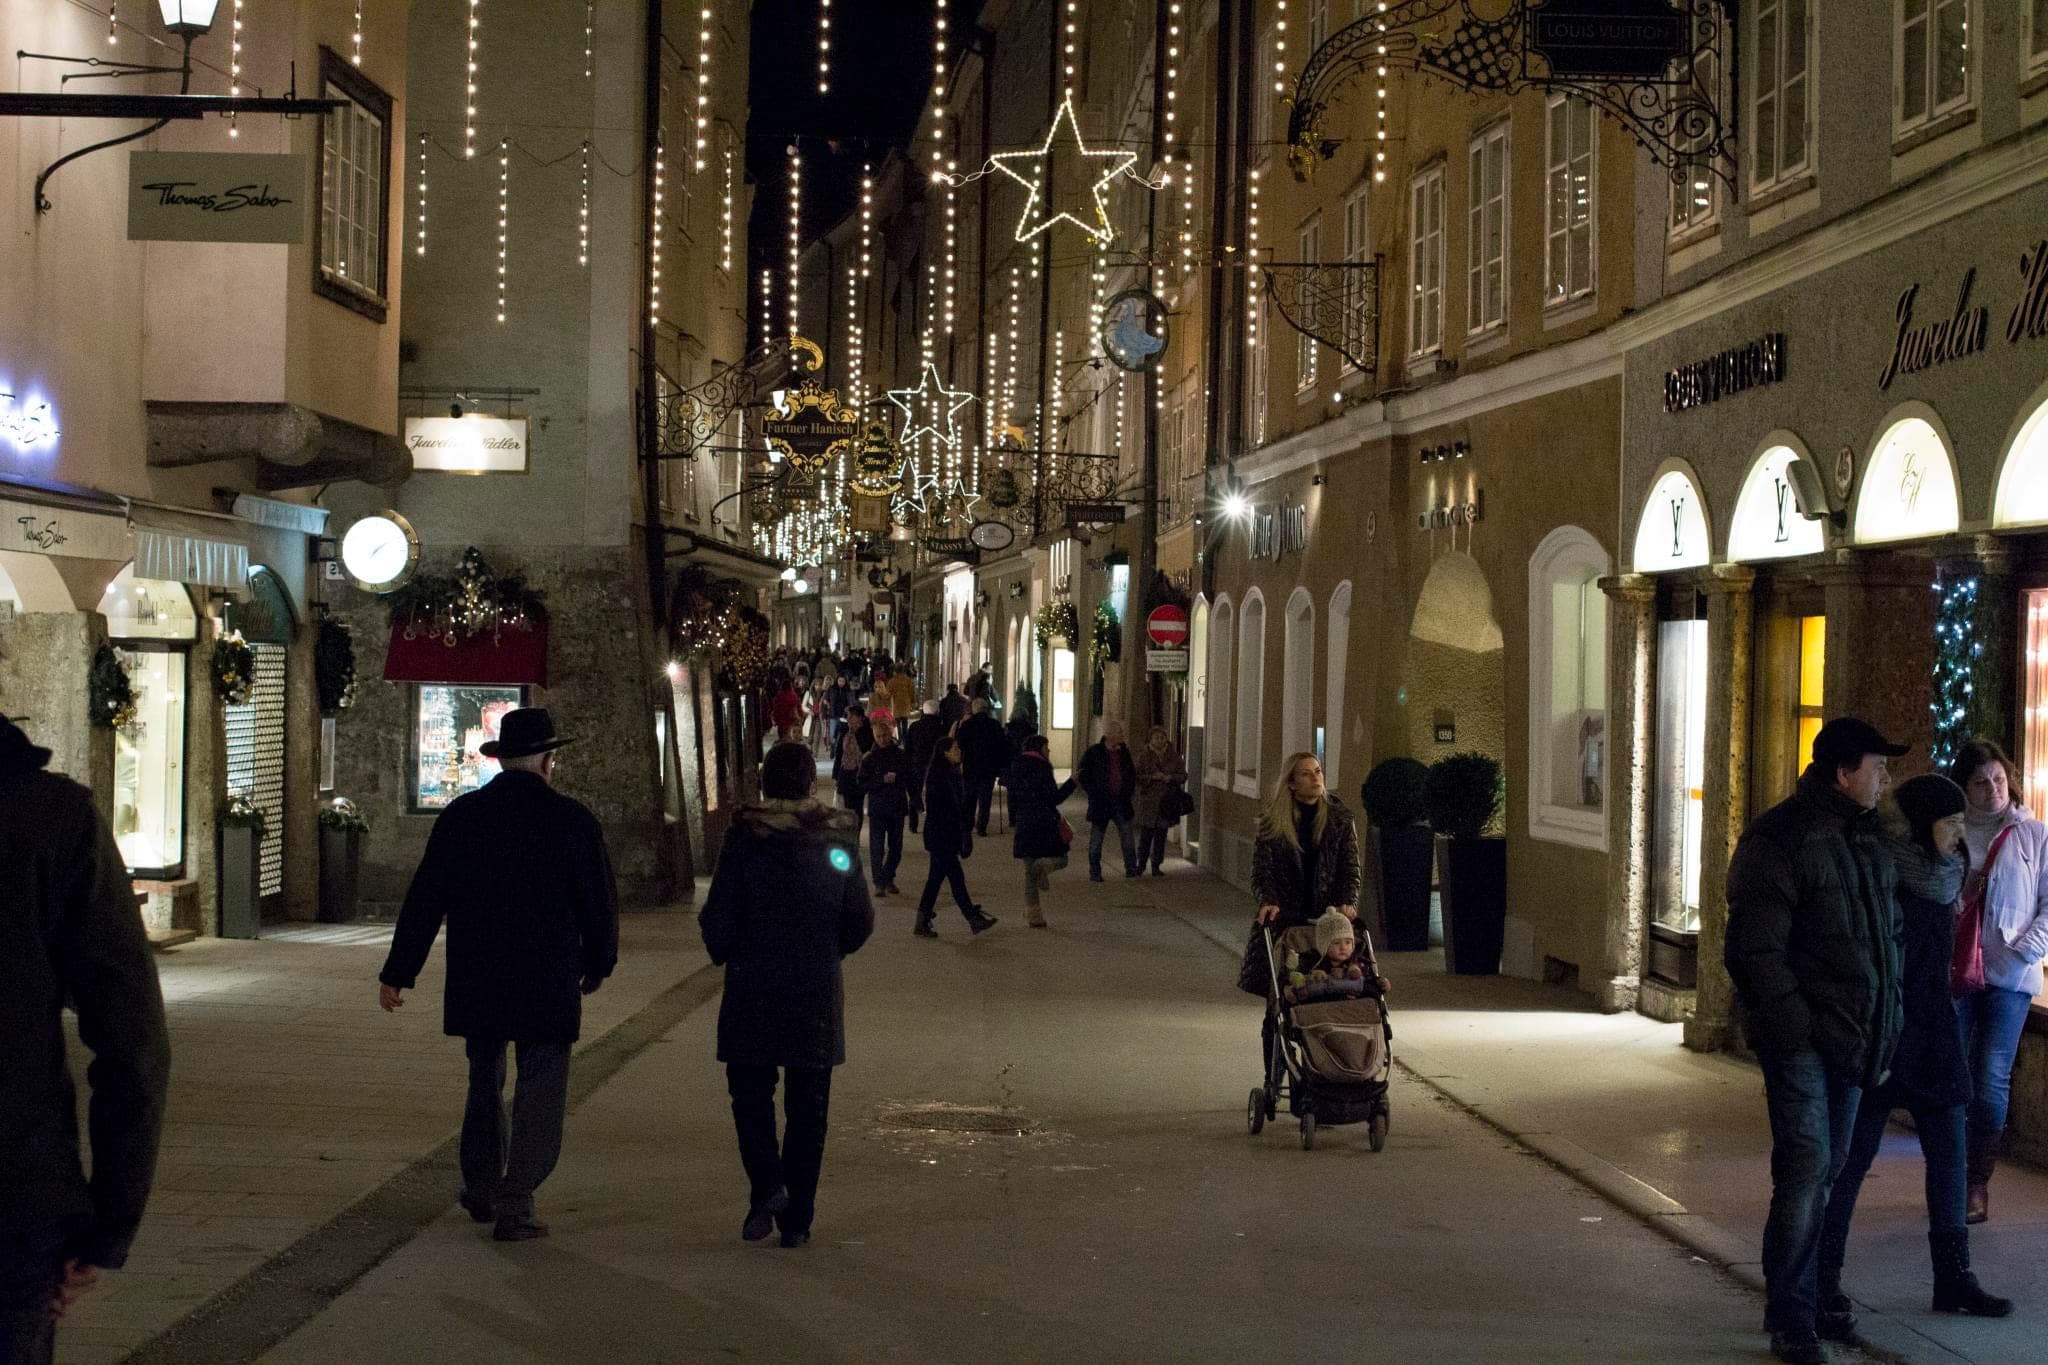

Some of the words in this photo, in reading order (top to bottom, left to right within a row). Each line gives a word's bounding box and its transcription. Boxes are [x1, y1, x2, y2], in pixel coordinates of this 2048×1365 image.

[1547, 23, 1595, 39] LOUIS
[1602, 24, 1667, 40] VUITTON
[141, 182, 216, 210] Thomas
[213, 184, 293, 212] Sabo
[1878, 266, 1988, 390] Juwelen
[1663, 361, 1702, 413] LOUIS
[1700, 333, 1786, 405] VUITTON
[811, 422, 853, 434] Hanisch
